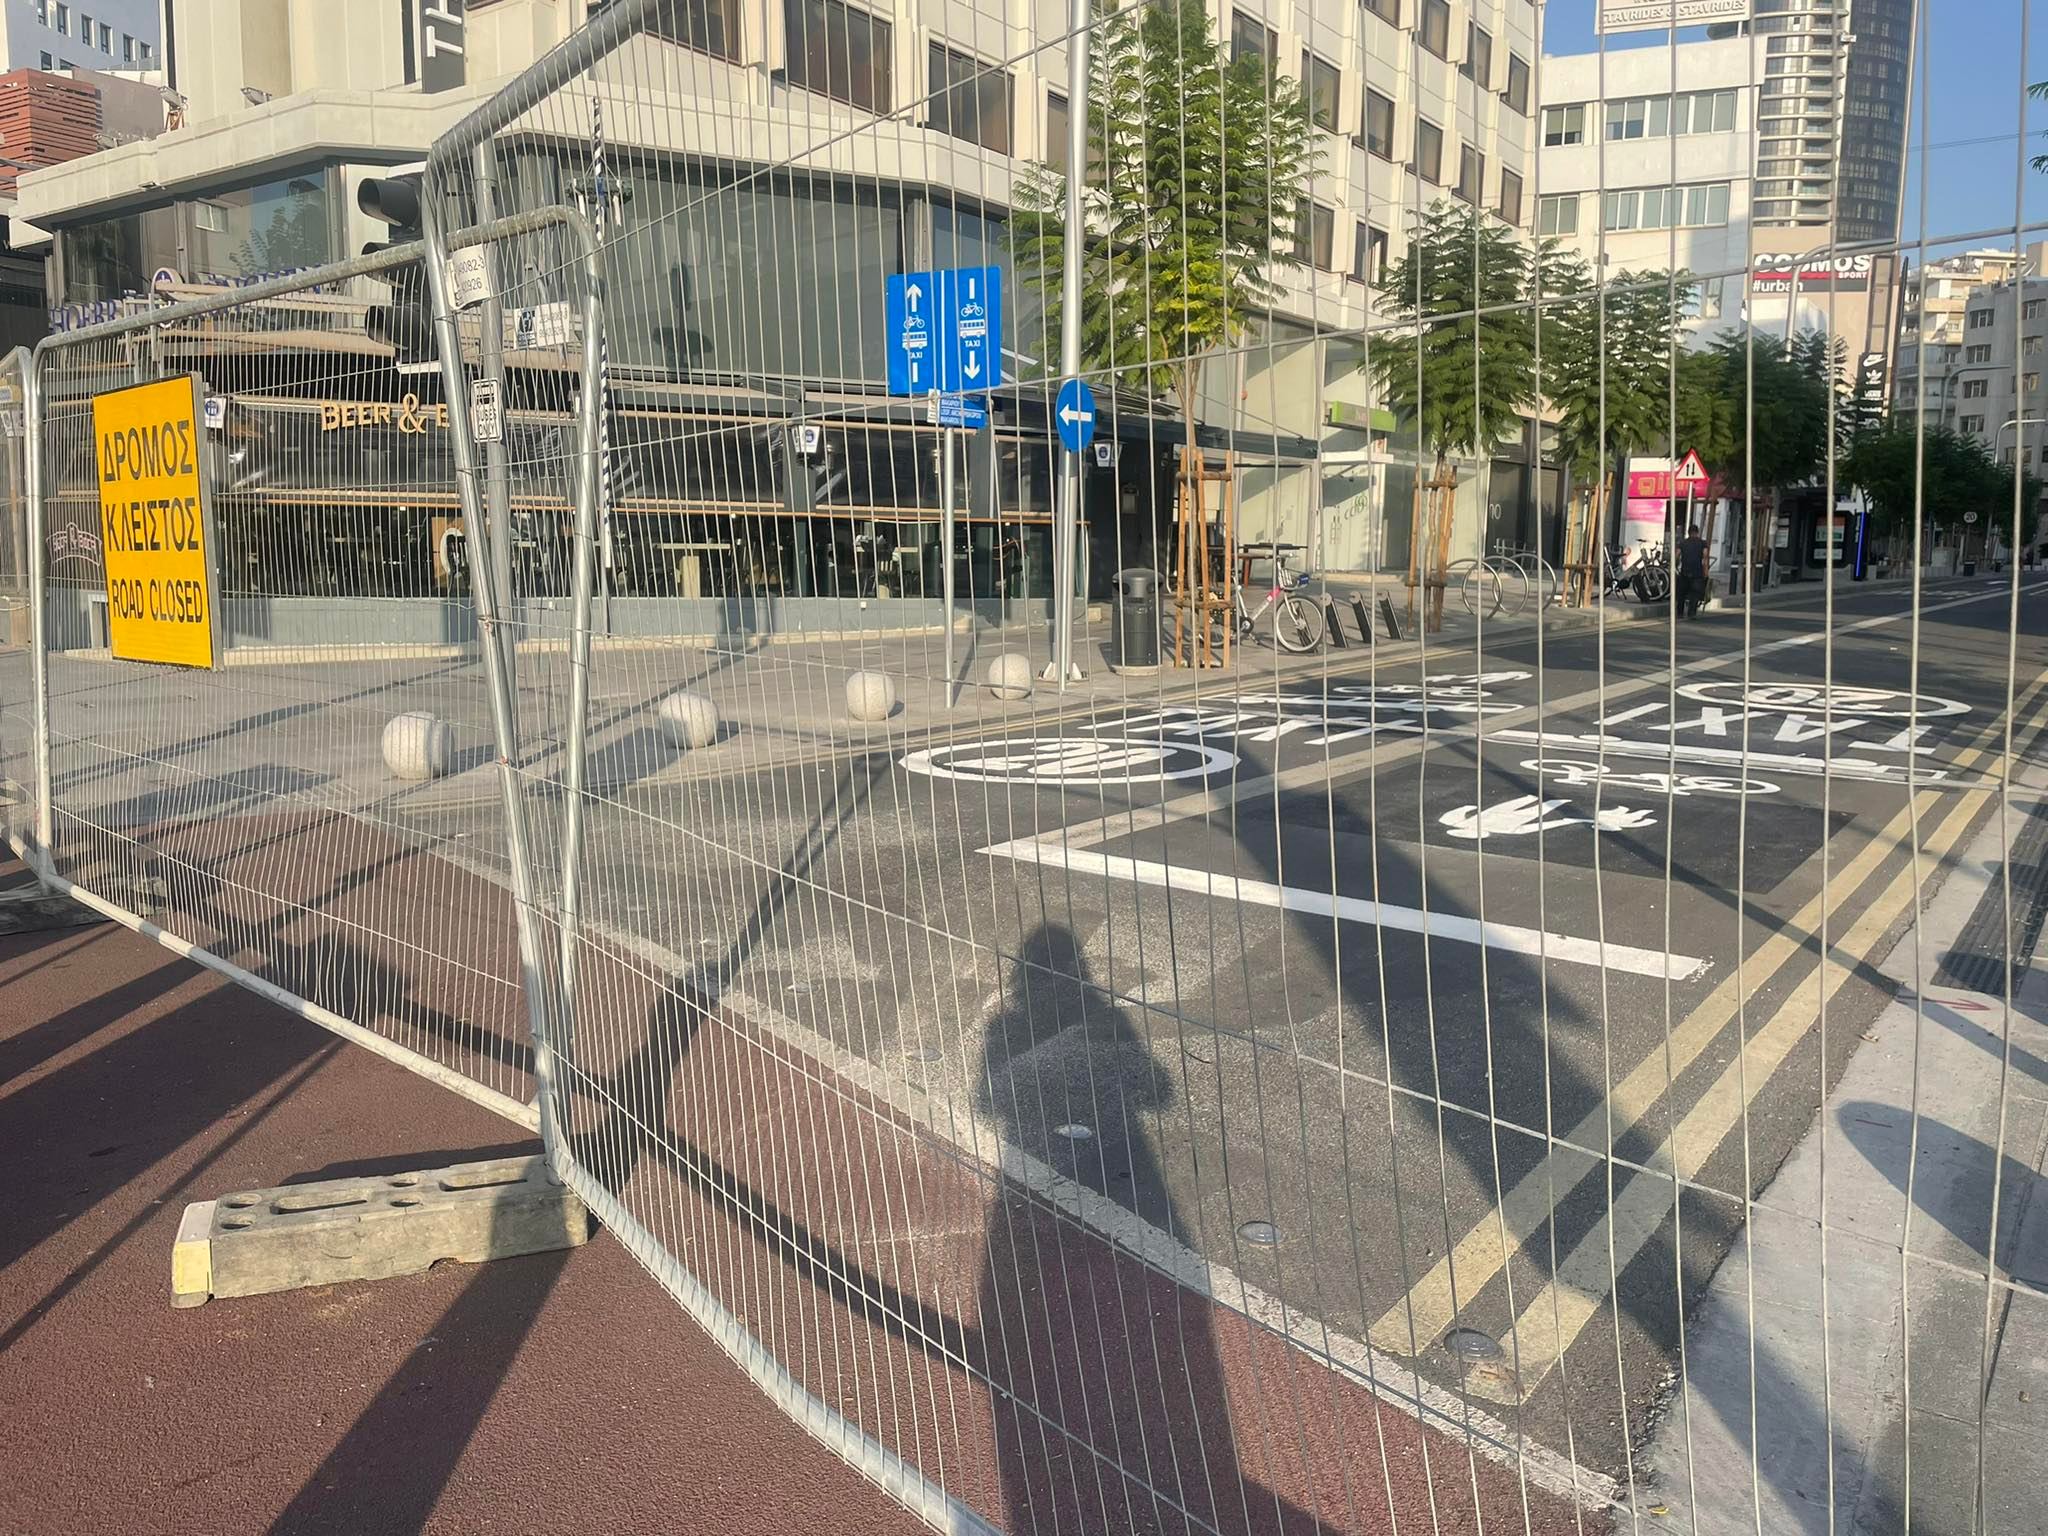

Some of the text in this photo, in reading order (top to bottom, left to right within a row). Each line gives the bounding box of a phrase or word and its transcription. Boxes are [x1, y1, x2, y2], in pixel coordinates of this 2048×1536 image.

[1602, 8, 1664, 23] TAVRIDES
[1679, 0, 1746, 16] STAVRIDES
[964, 339, 981, 348] TAXI
[320, 401, 391, 431] BEER
[399, 392, 428, 434] &
[104, 420, 193, 482] ΔΡΟΜΟΣ
[106, 497, 199, 552] ΚΛΕΙΣΤΟΣ
[1966, 512, 1976, 521] 20
[112, 579, 203, 623] ROAD CLOSED
[1078, 706, 1418, 745] TAXI
[1593, 703, 1937, 755] TAXI
[943, 742, 1179, 776] 20
